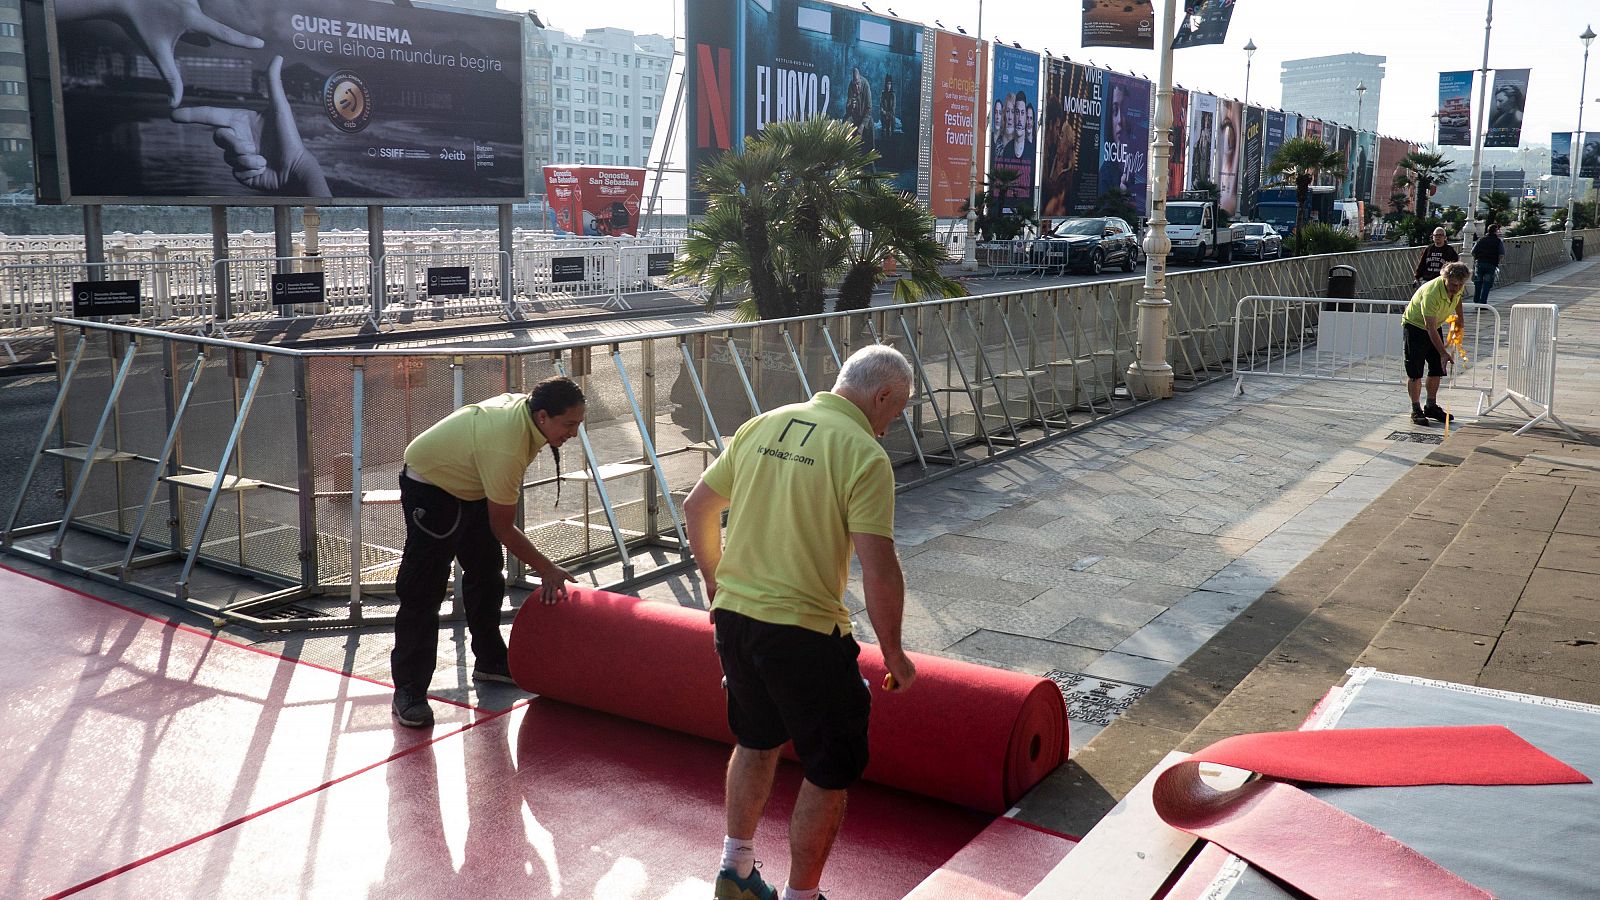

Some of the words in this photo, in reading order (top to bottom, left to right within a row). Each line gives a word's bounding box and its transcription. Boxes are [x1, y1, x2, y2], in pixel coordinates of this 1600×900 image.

[292, 14, 342, 36] GURE
[347, 22, 412, 45] ZINEMA
[293, 34, 333, 52] Gure
[339, 38, 384, 59] leihoa
[390, 48, 455, 66] mundura
[460, 53, 502, 72] begira
[1085, 66, 1102, 84] VIVIR
[697, 44, 730, 150] N
[777, 68, 817, 125] HOYO
[821, 75, 830, 118] 2
[1093, 85, 1101, 100] EL
[1064, 96, 1101, 116] MOMENTO
[945, 110, 972, 127] festival
[946, 128, 973, 145] favorit
[1248, 122, 1259, 140] cine
[380, 148, 404, 158] SSIFF
[448, 150, 465, 160] eitb
[1104, 142, 1127, 163] SIGUE
[757, 445, 815, 466] loyola21.com
